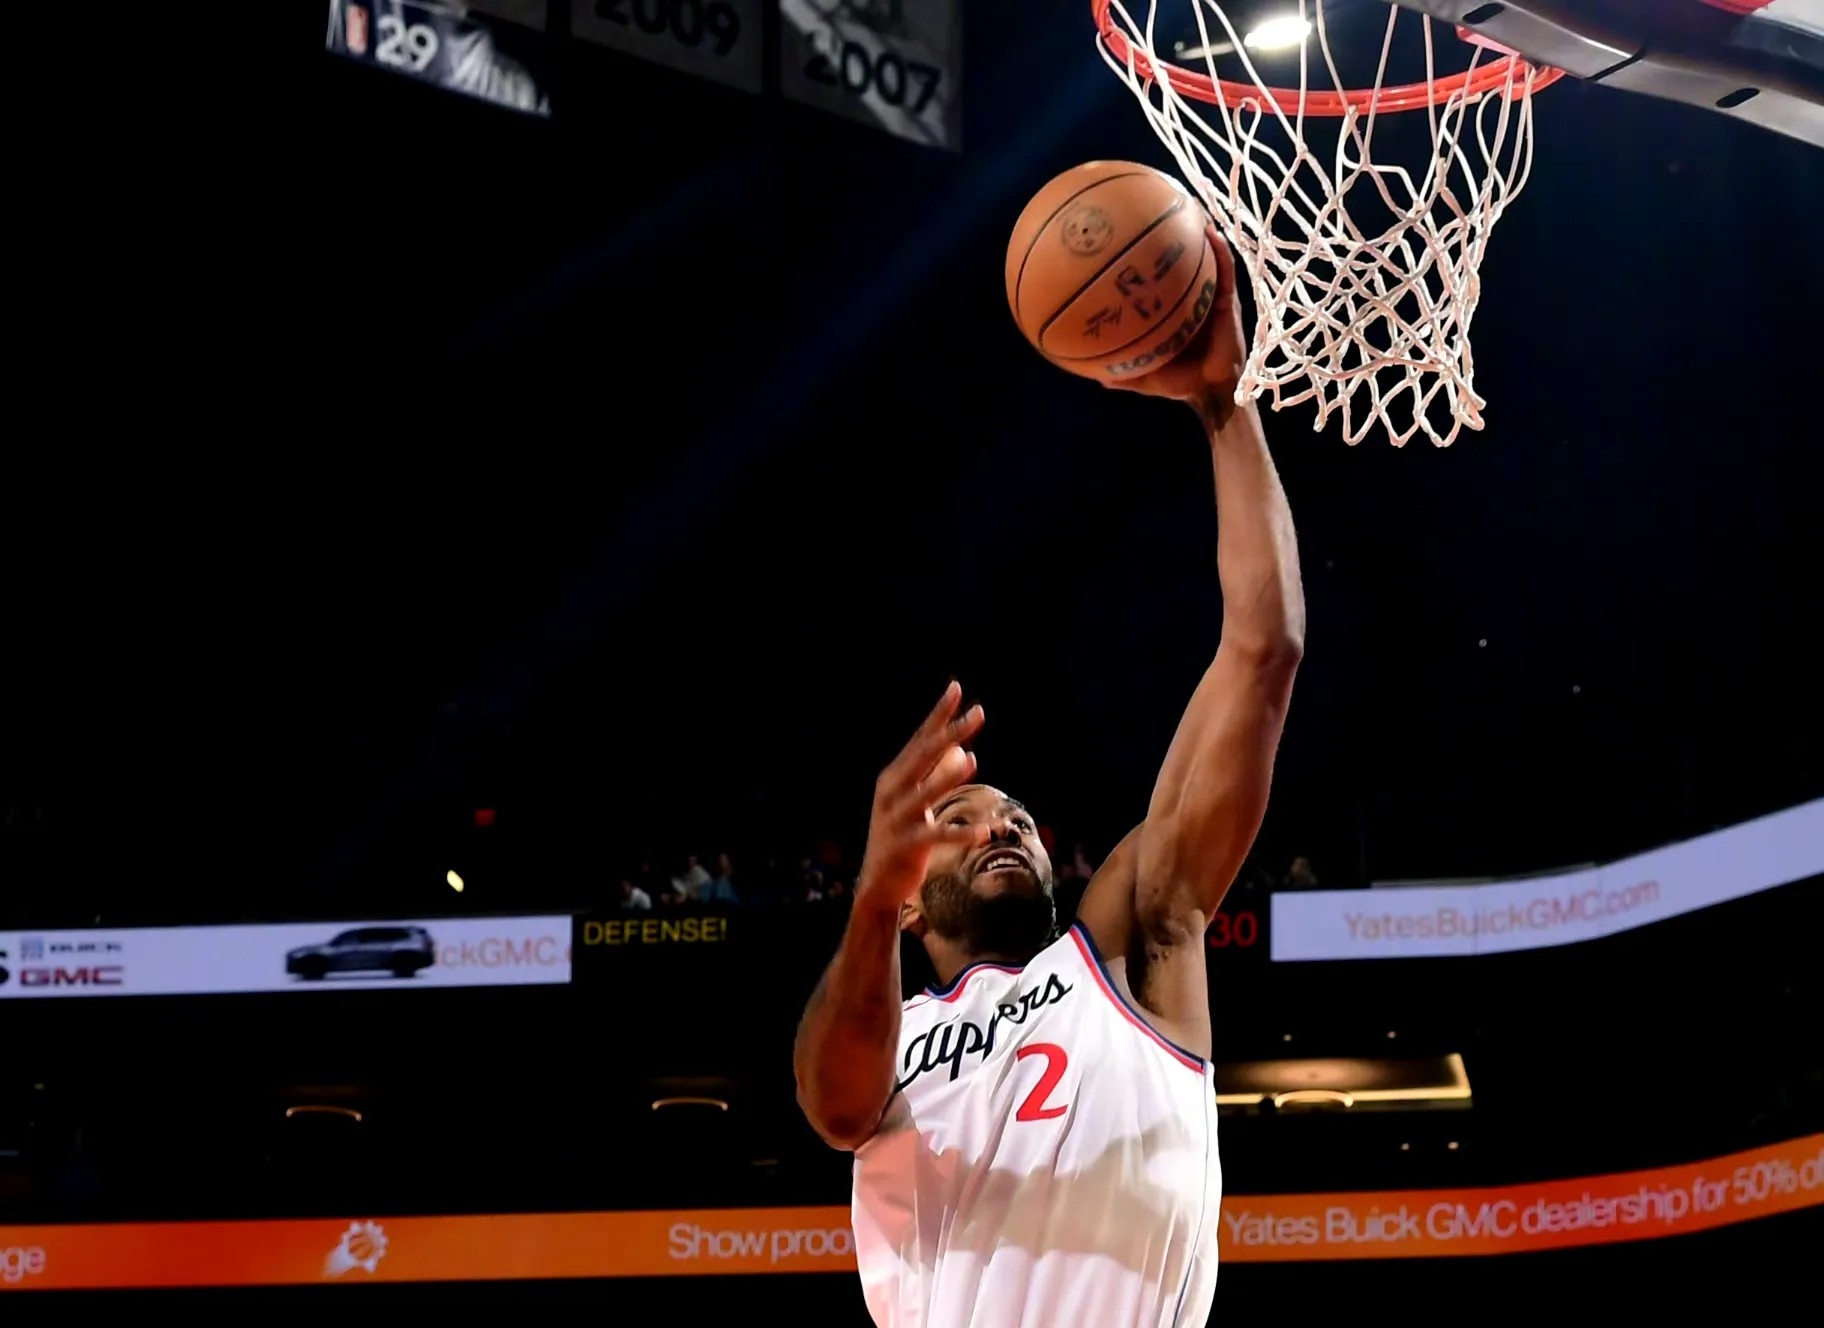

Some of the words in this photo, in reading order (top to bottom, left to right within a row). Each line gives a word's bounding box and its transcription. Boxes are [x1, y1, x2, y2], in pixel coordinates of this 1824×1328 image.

[374, 14, 439, 72] 29
[806, 33, 941, 112] 2007
[583, 917, 727, 946] DEFENSE!
[1343, 879, 1660, 943] YatesBuickGMC.com
[20, 965, 125, 987] GMC
[1015, 1042, 1069, 1122] 2
[668, 1223, 767, 1260] Show
[771, 1227, 856, 1264] proo
[1224, 1210, 1320, 1248] Yates
[1326, 1205, 1422, 1244] Buick
[1427, 1199, 1518, 1240] GMC
[1521, 1181, 1690, 1235] dealership
[1692, 1174, 1731, 1214] for
[1732, 1159, 1799, 1205] 50%
[0, 1245, 46, 1284] ge
